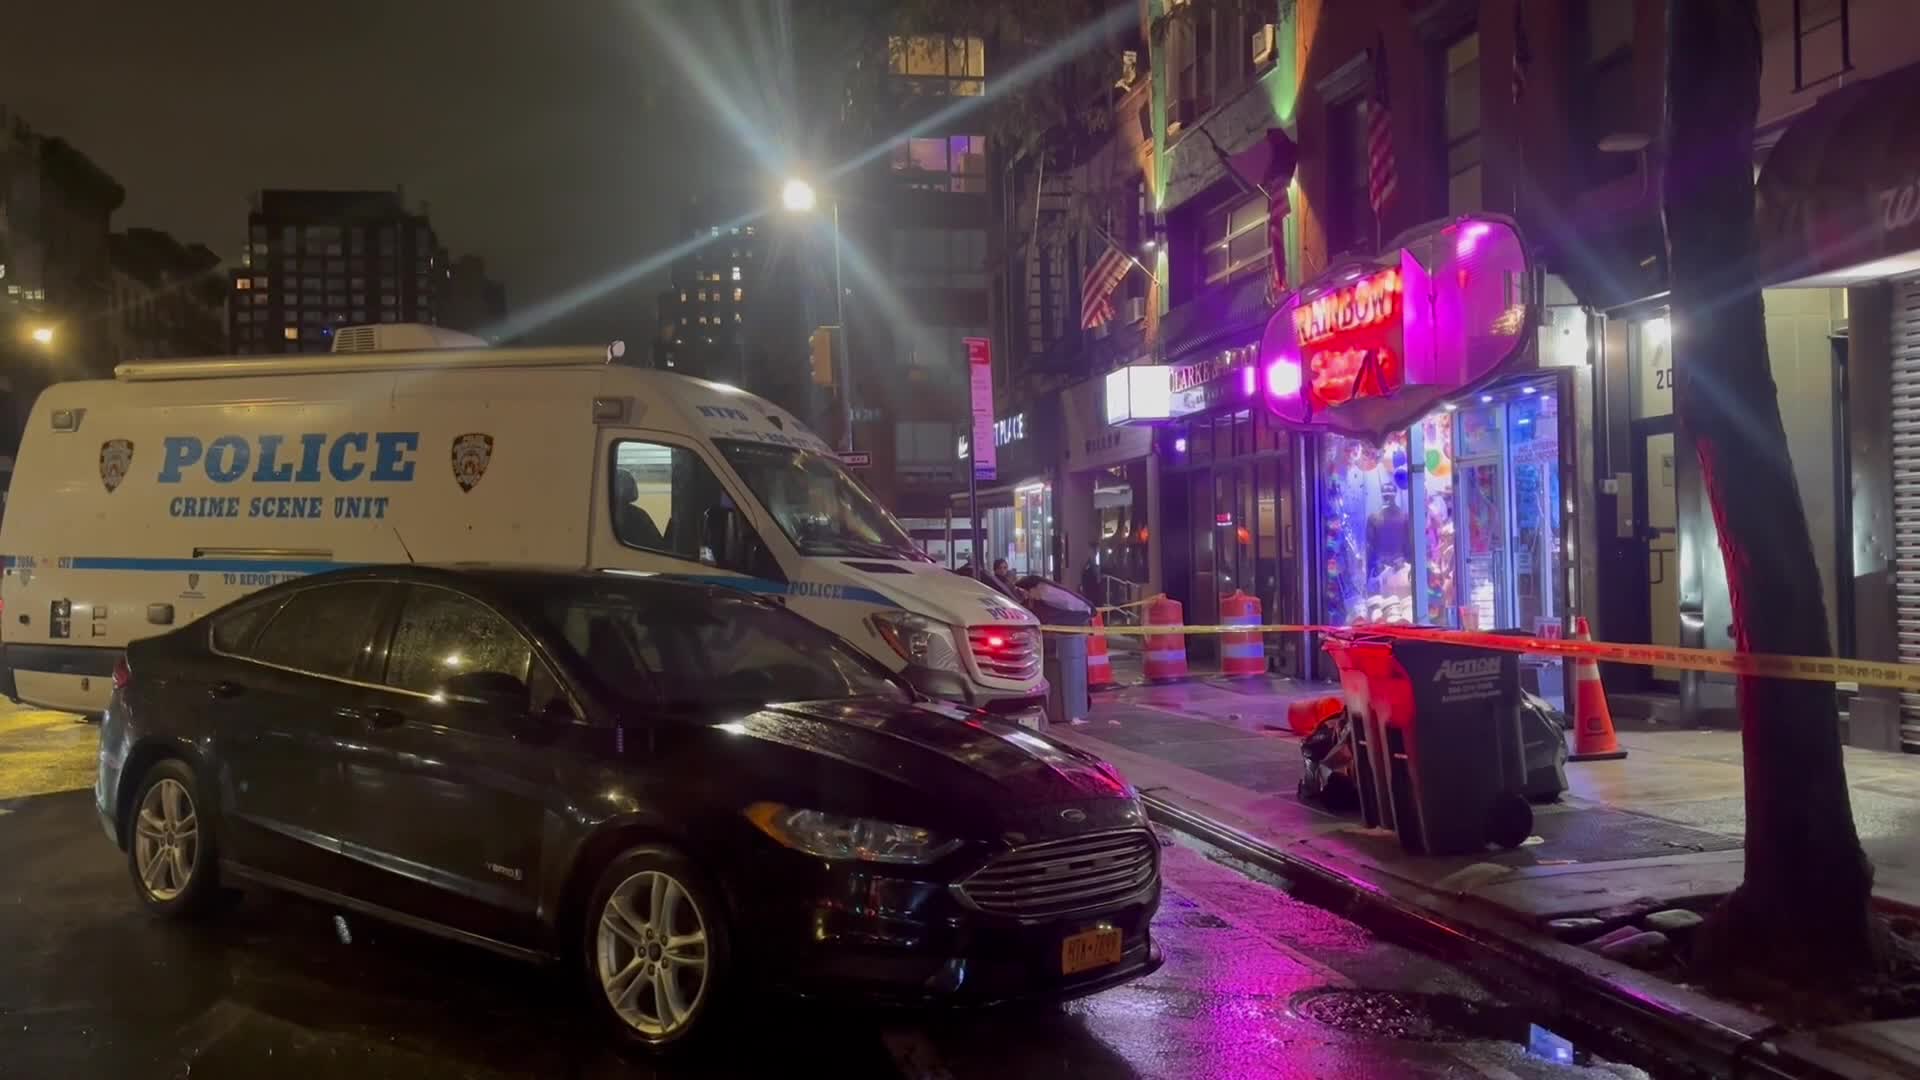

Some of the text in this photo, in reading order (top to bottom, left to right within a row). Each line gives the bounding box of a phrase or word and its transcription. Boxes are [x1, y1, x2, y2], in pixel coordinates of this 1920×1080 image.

[157, 432, 420, 483] POLICE
[169, 496, 389, 518] CRIME SCENE UNIT
[223, 573, 237, 585] TO
[240, 573, 279, 585] REPORT
[787, 581, 842, 599] POLICE
[1432, 655, 1502, 681] ACTION
